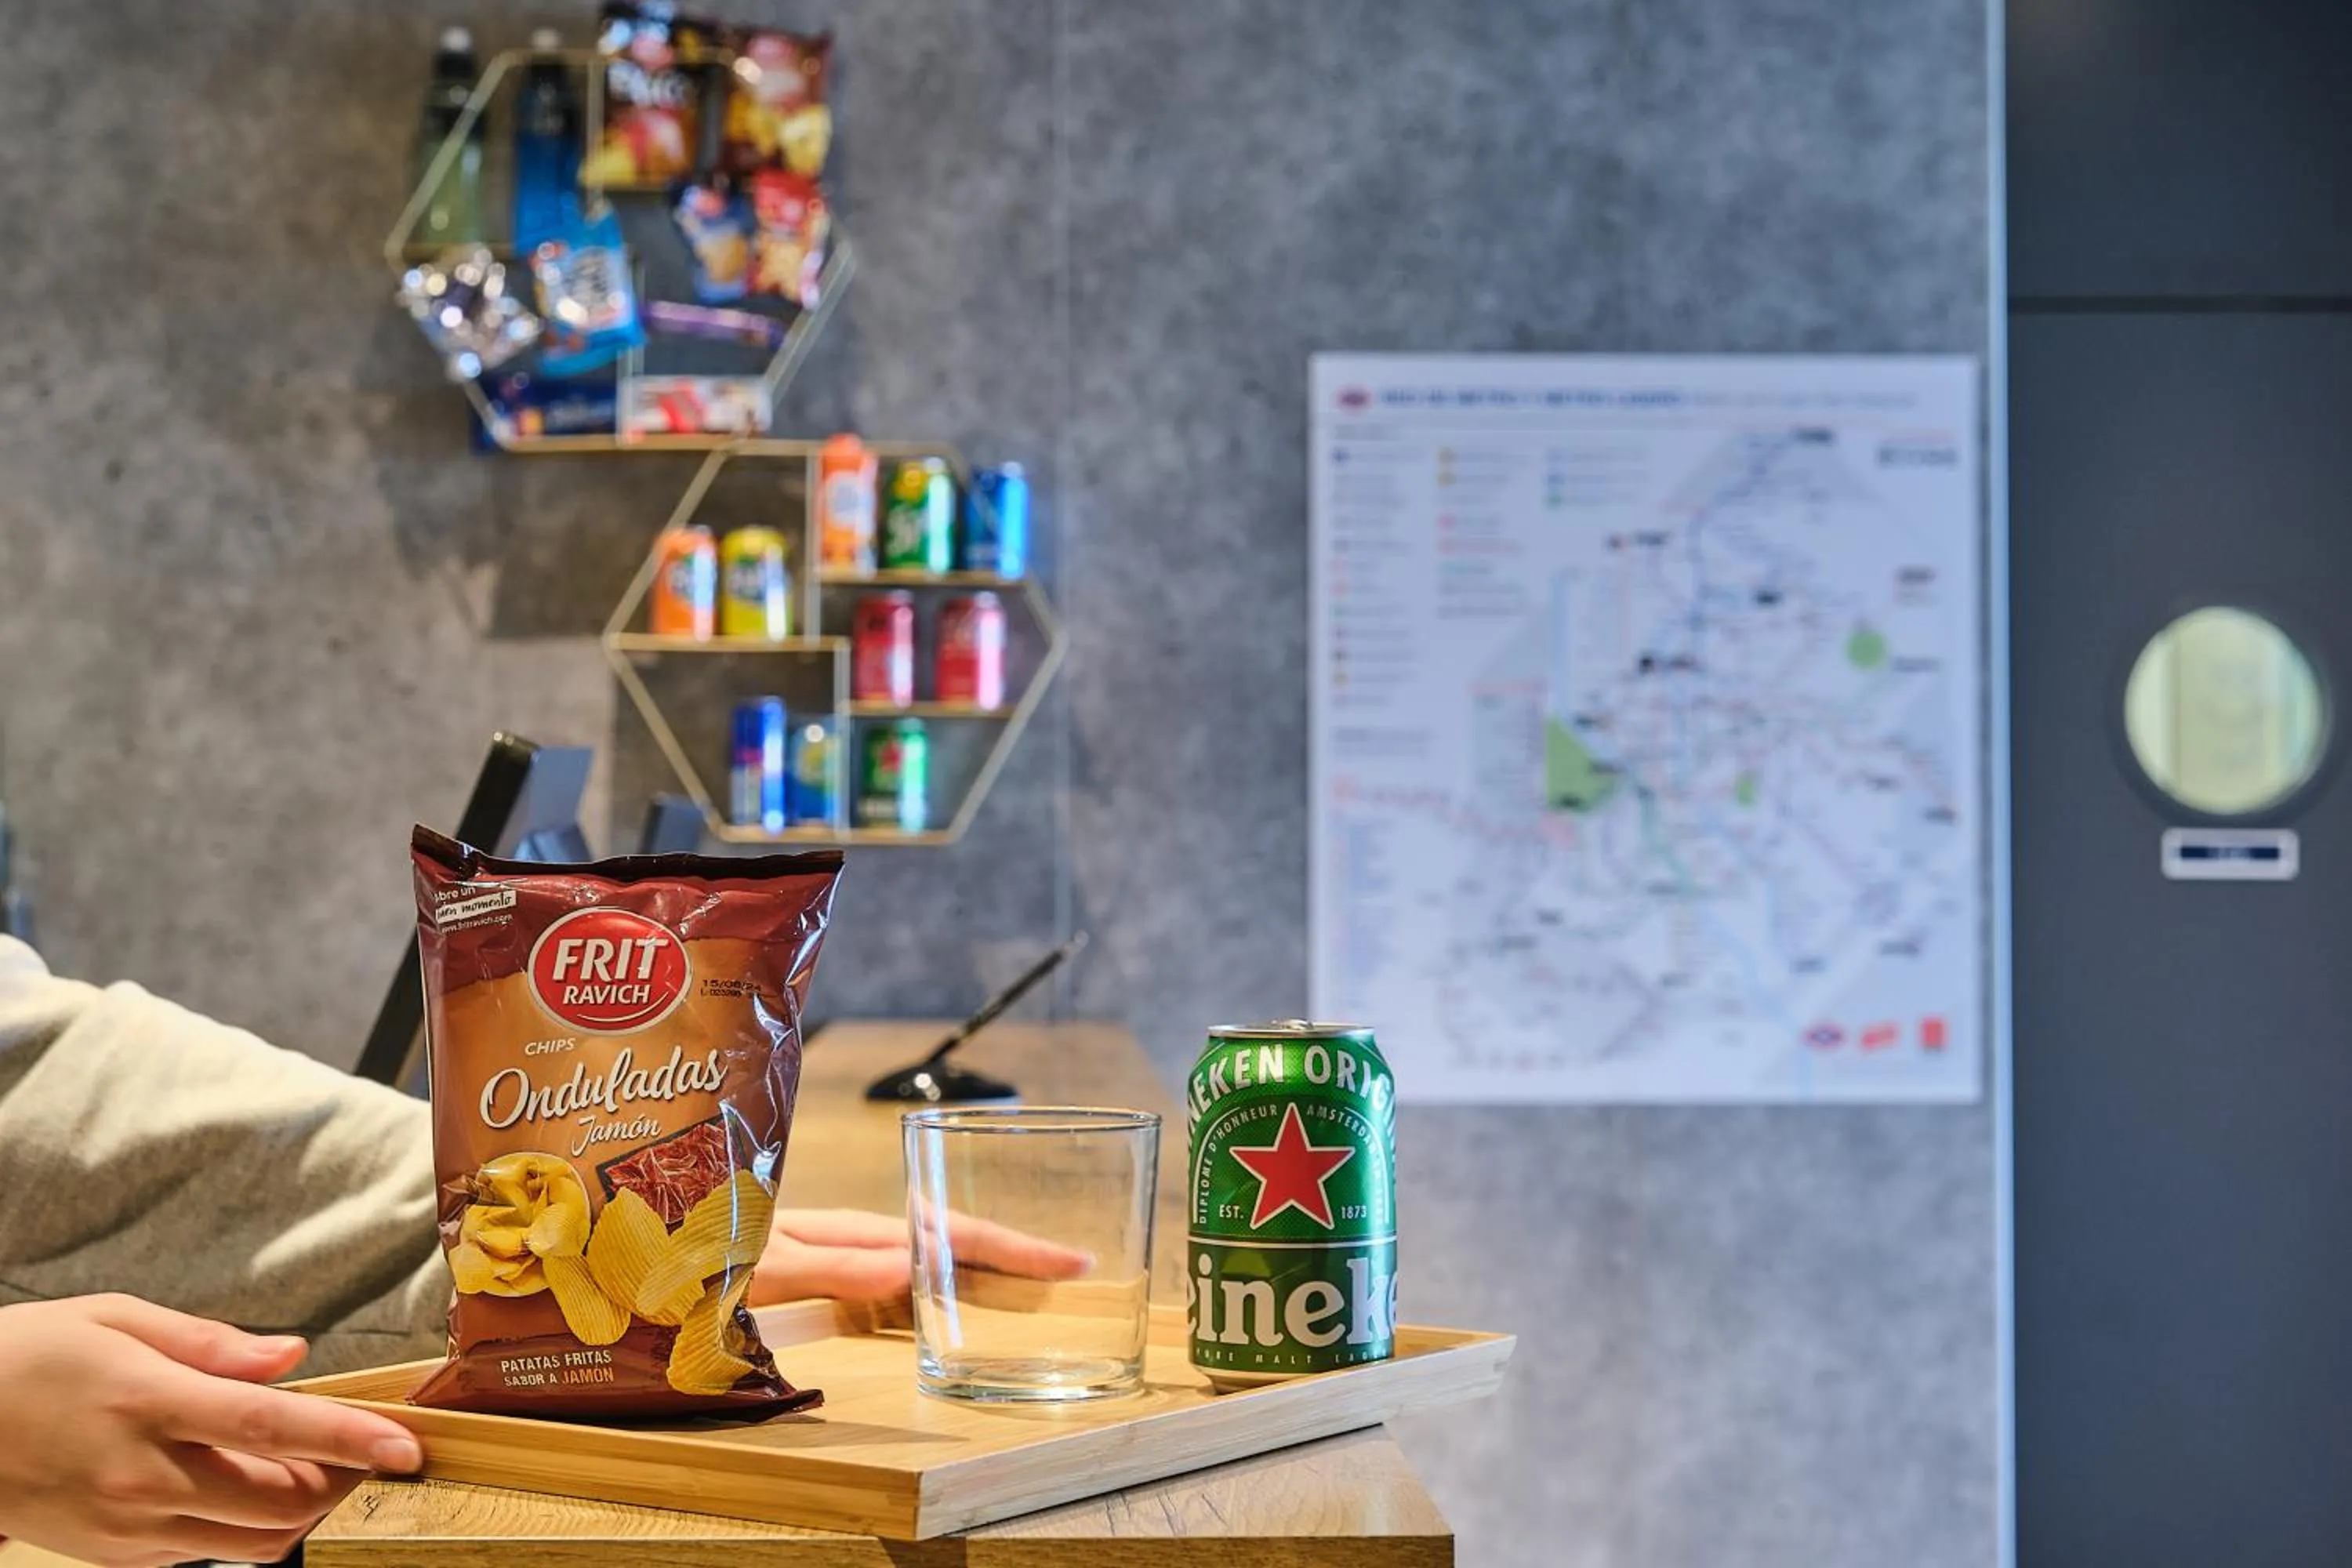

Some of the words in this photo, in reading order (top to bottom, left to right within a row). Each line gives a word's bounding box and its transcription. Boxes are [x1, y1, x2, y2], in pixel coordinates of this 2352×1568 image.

[460, 887, 476, 897] un
[462, 892, 512, 913] momento
[553, 938, 669, 982] FRIT
[563, 985, 650, 1004] RAVICH
[524, 1038, 575, 1055] CHIPS
[479, 1045, 728, 1129] Onduladas
[572, 1114, 662, 1156] Jamón
[1219, 1204, 1244, 1218] EST.
[1341, 1205, 1368, 1219] 1873
[1188, 1254, 1397, 1348] inek
[501, 1356, 561, 1372] PATATAS
[564, 1350, 612, 1367] FRITAS
[504, 1374, 545, 1386] SABOR
[550, 1374, 558, 1384] A
